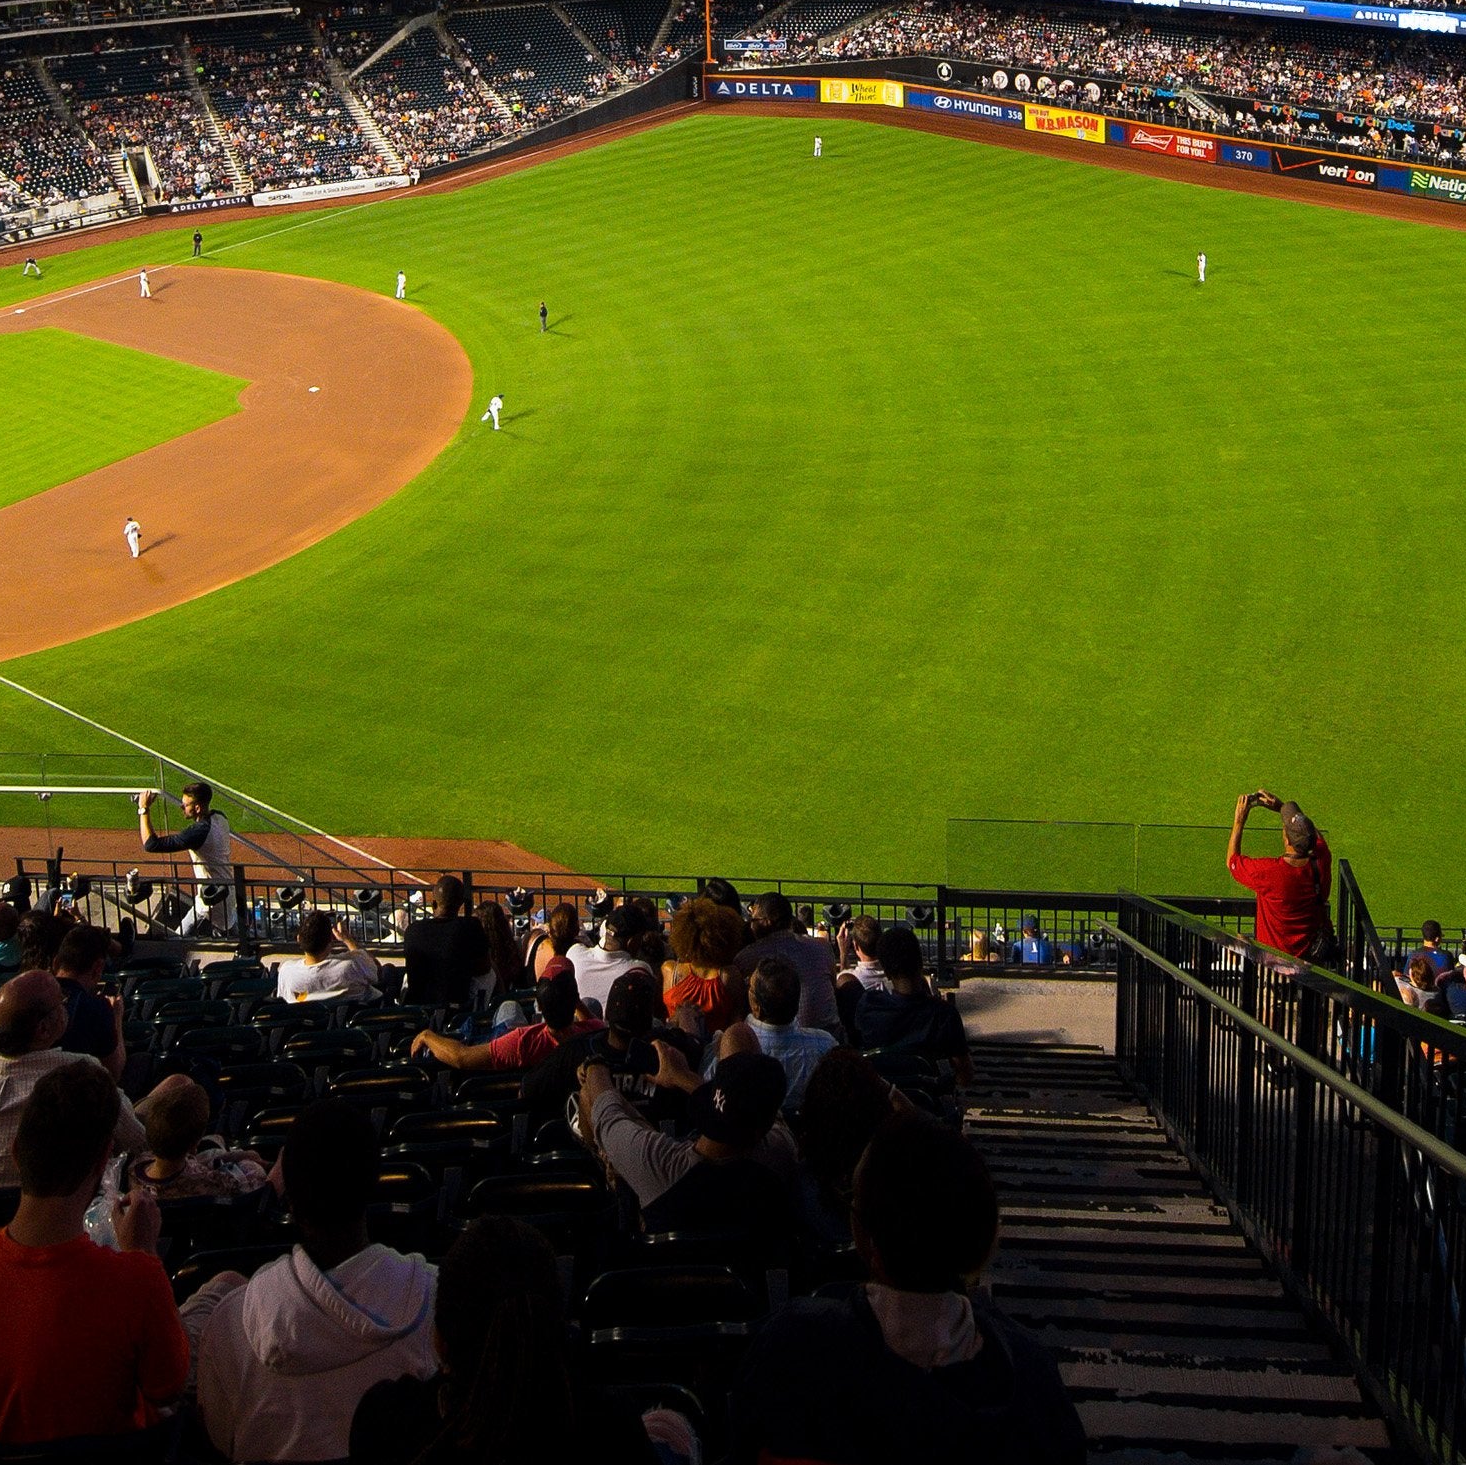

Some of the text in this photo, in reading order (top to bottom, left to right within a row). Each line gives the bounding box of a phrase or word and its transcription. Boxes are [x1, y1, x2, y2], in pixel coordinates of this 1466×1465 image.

[736, 82, 793, 96] DELTA
[851, 83, 876, 94] Wheat
[954, 99, 1002, 117] HYUNDAI
[1008, 110, 1022, 120] 358
[1176, 135, 1213, 150] THIS BUD'S
[1176, 144, 1189, 155] FOR
[1235, 150, 1253, 161] 370
[1318, 164, 1375, 183] verizon
[1449, 192, 1461, 200] Car
[180, 196, 247, 211] DELTA DELTA
